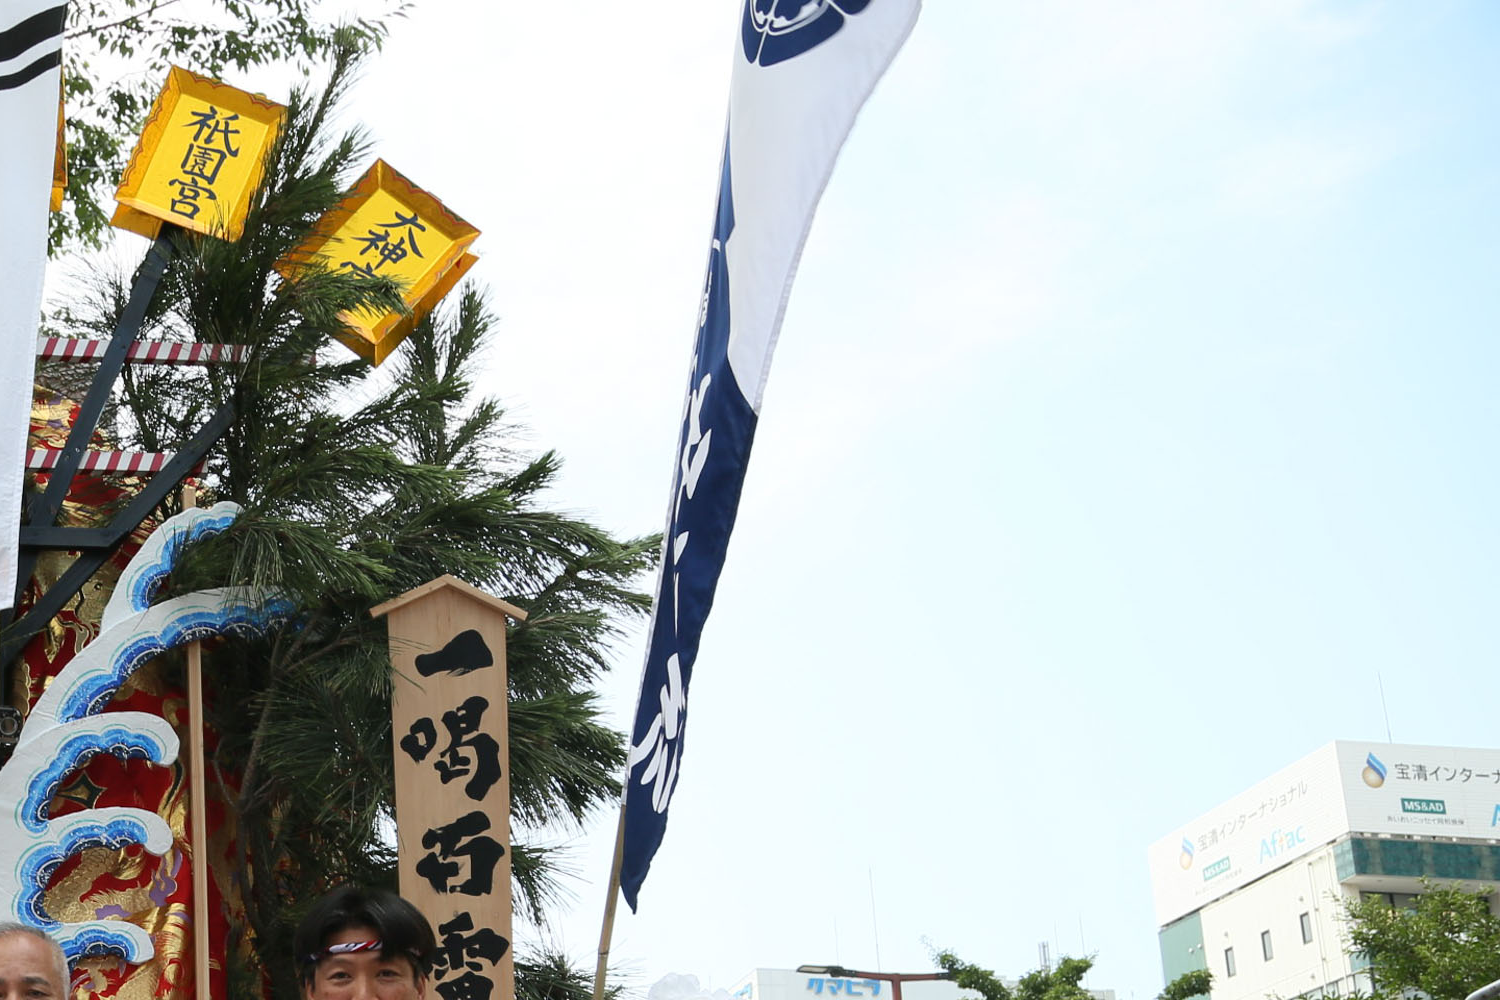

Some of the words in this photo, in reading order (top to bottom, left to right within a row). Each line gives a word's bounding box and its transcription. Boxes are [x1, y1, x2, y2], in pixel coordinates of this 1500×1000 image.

[169, 106, 240, 219] 祇園宮
[1403, 801, 1444, 812] MS&AD
[806, 978, 881, 996] クマヒラ
